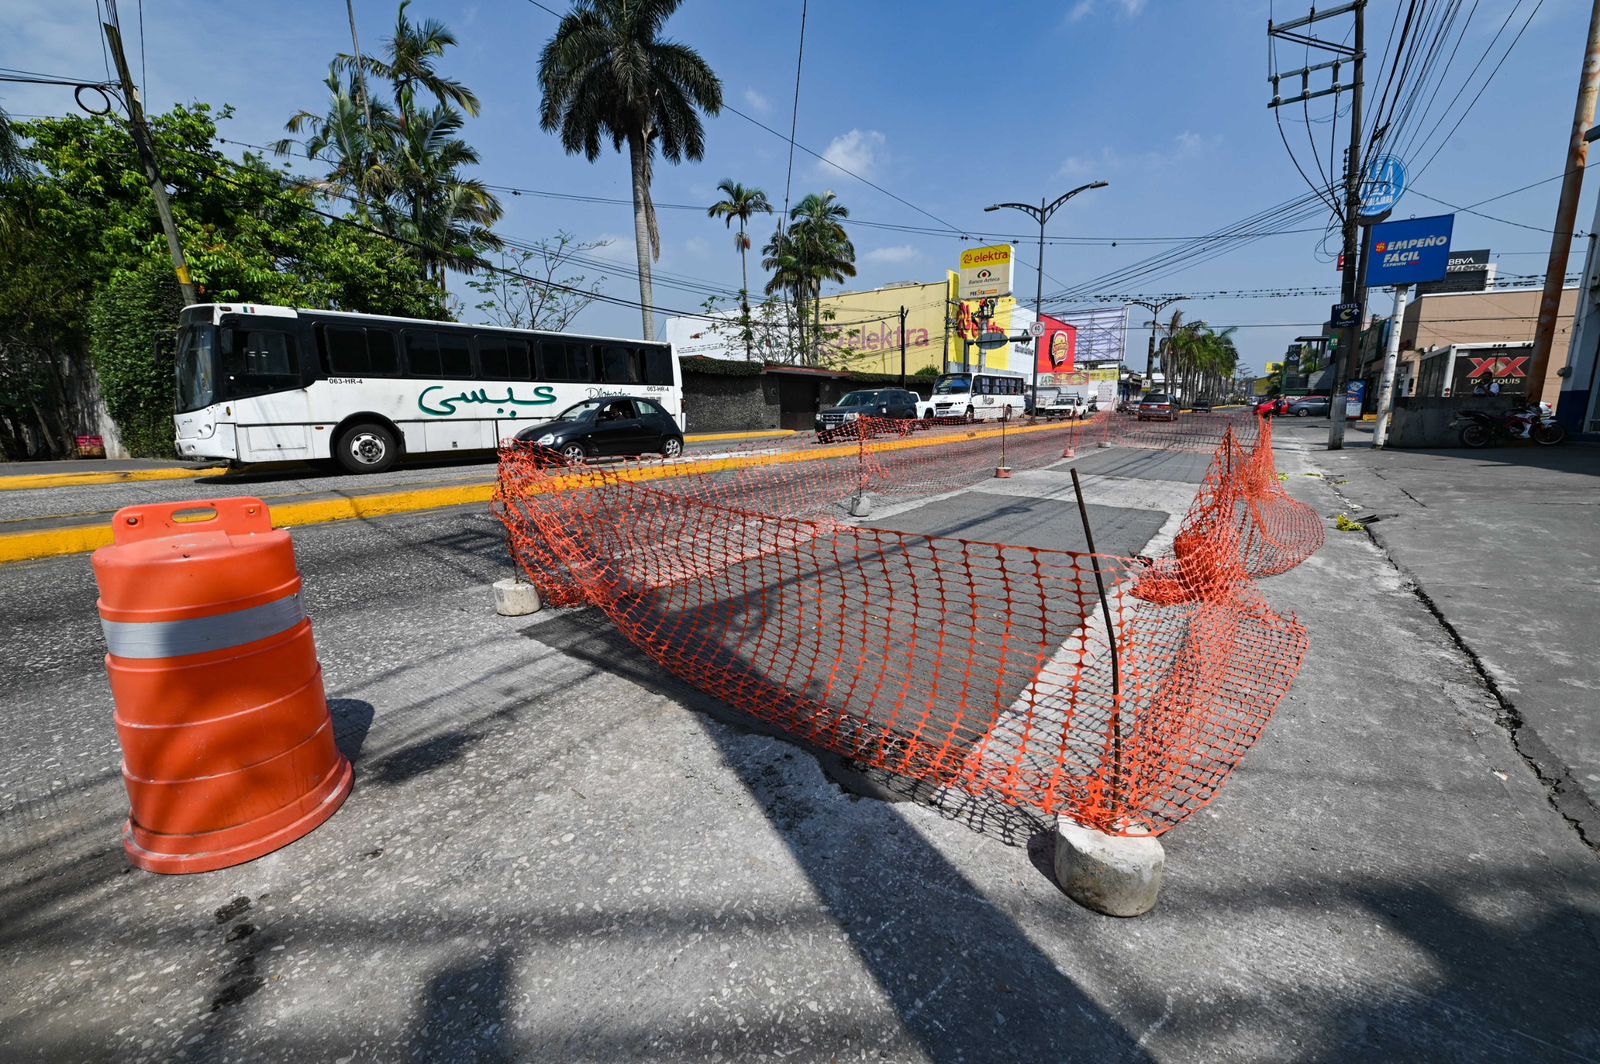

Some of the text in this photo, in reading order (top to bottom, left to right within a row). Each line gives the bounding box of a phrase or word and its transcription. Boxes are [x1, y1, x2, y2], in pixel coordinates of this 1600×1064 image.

[1387, 235, 1447, 251] EMPEÑO
[974, 251, 1008, 263] elektra
[1383, 251, 1420, 263] FÁCIL
[1448, 257, 1474, 265] BBVA
[848, 323, 929, 351] elektra
